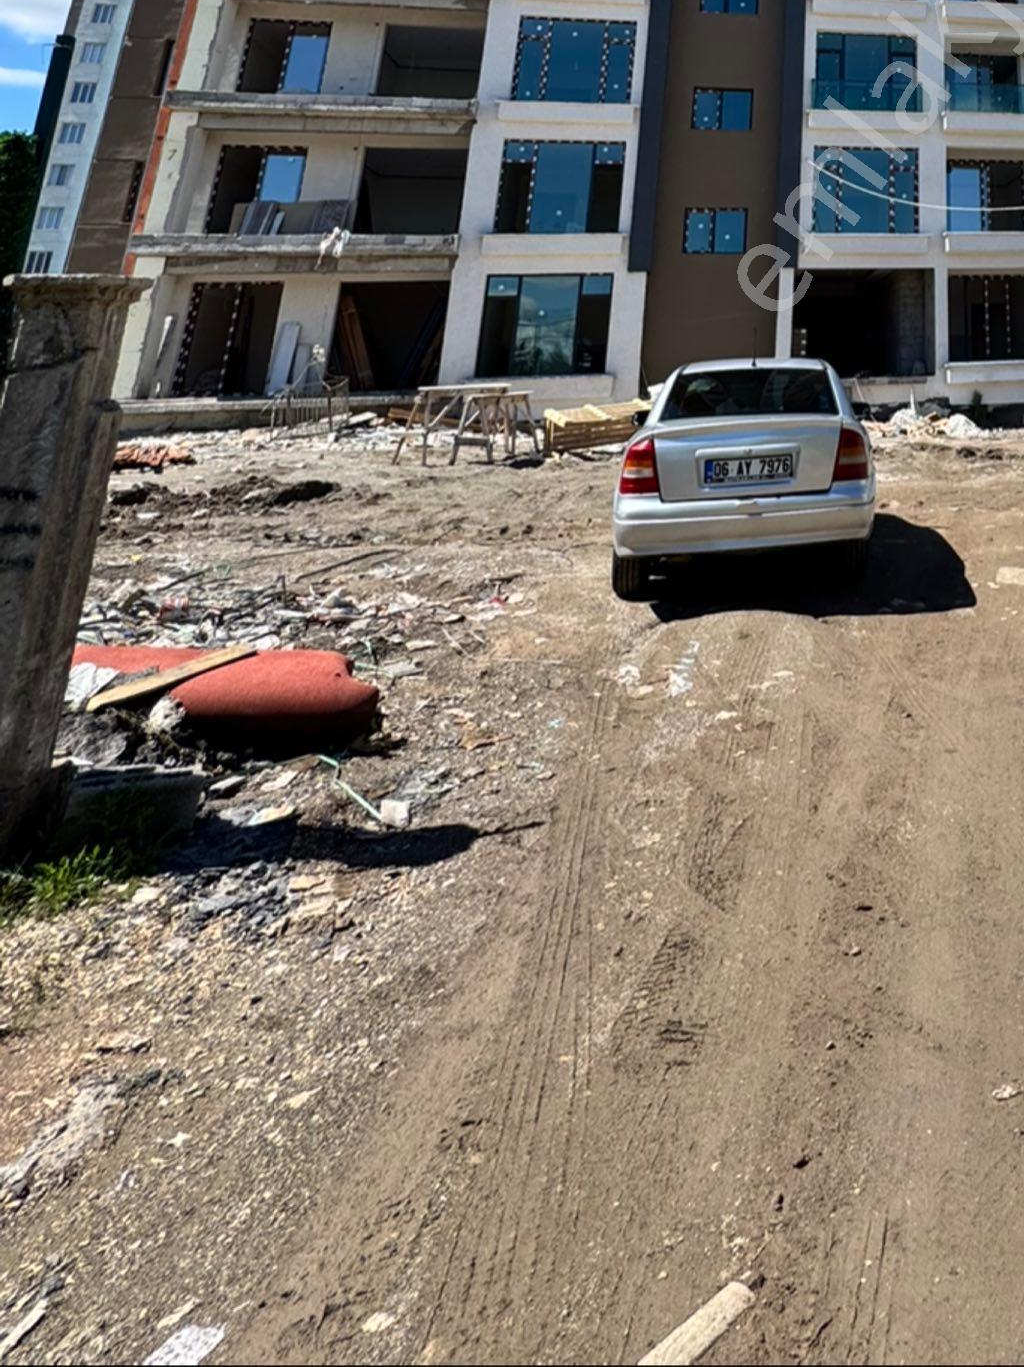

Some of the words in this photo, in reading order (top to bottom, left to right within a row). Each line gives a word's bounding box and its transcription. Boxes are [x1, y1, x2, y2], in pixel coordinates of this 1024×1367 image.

[714, 462, 729, 477] 06
[737, 460, 752, 476] AY
[760, 457, 790, 474] 7976
